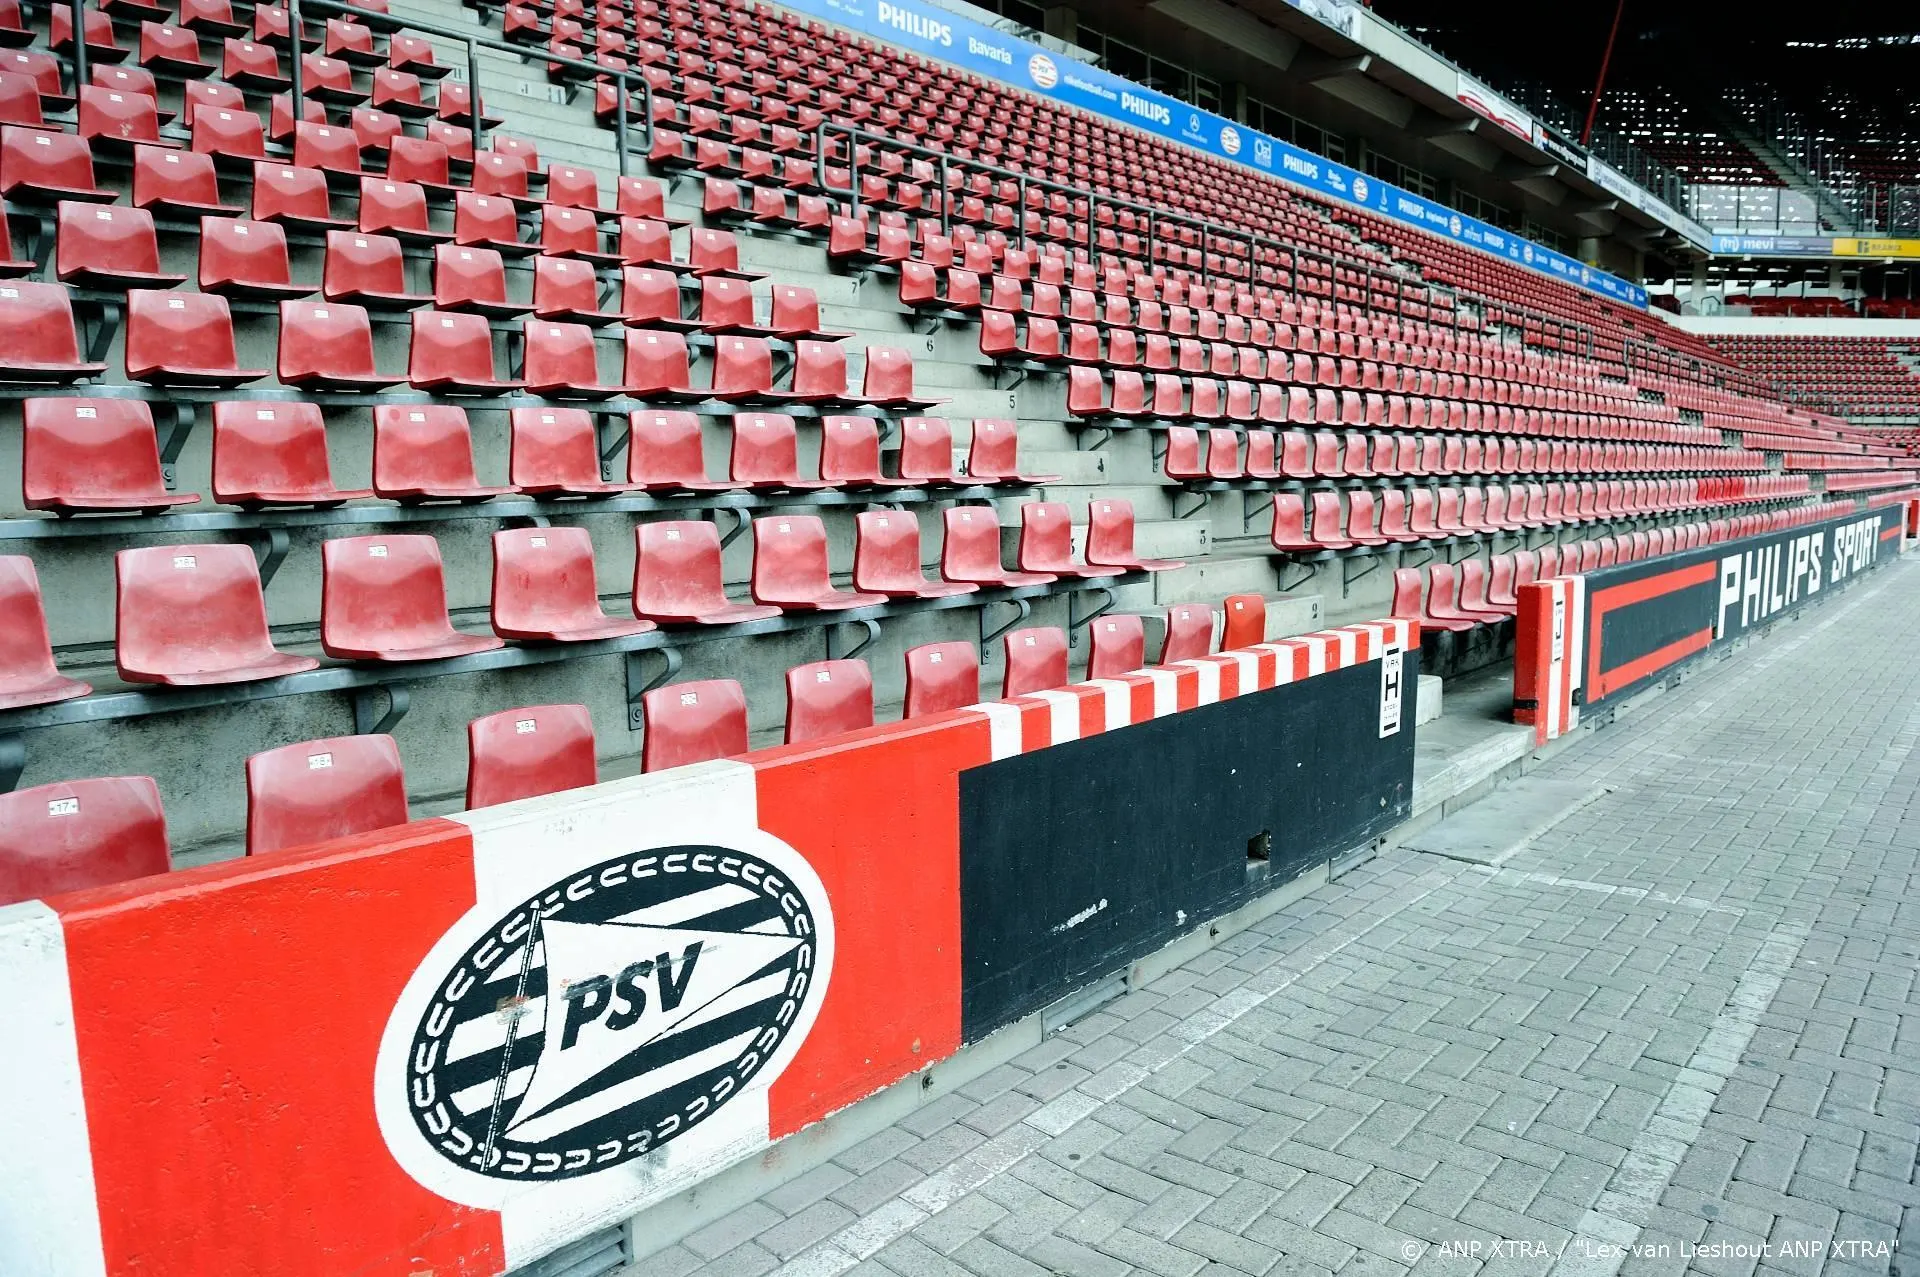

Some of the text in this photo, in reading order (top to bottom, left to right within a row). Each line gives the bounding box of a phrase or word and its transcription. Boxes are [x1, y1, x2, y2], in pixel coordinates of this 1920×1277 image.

[878, 1, 952, 47] PHILIPS
[968, 36, 1012, 65] Bavaria
[1121, 91, 1171, 126] PHILIPS
[1283, 153, 1319, 180] PHILIPS
[1743, 236, 1774, 251] mevi
[851, 281, 858, 294] 7
[925, 339, 934, 353] 6
[1009, 395, 1016, 409] 5
[1717, 515, 1882, 641] PHILIPS SPORT
[1555, 618, 1562, 640] J
[1385, 670, 1398, 702] H
[56, 801, 70, 813] 17
[560, 940, 704, 1051] PSV
